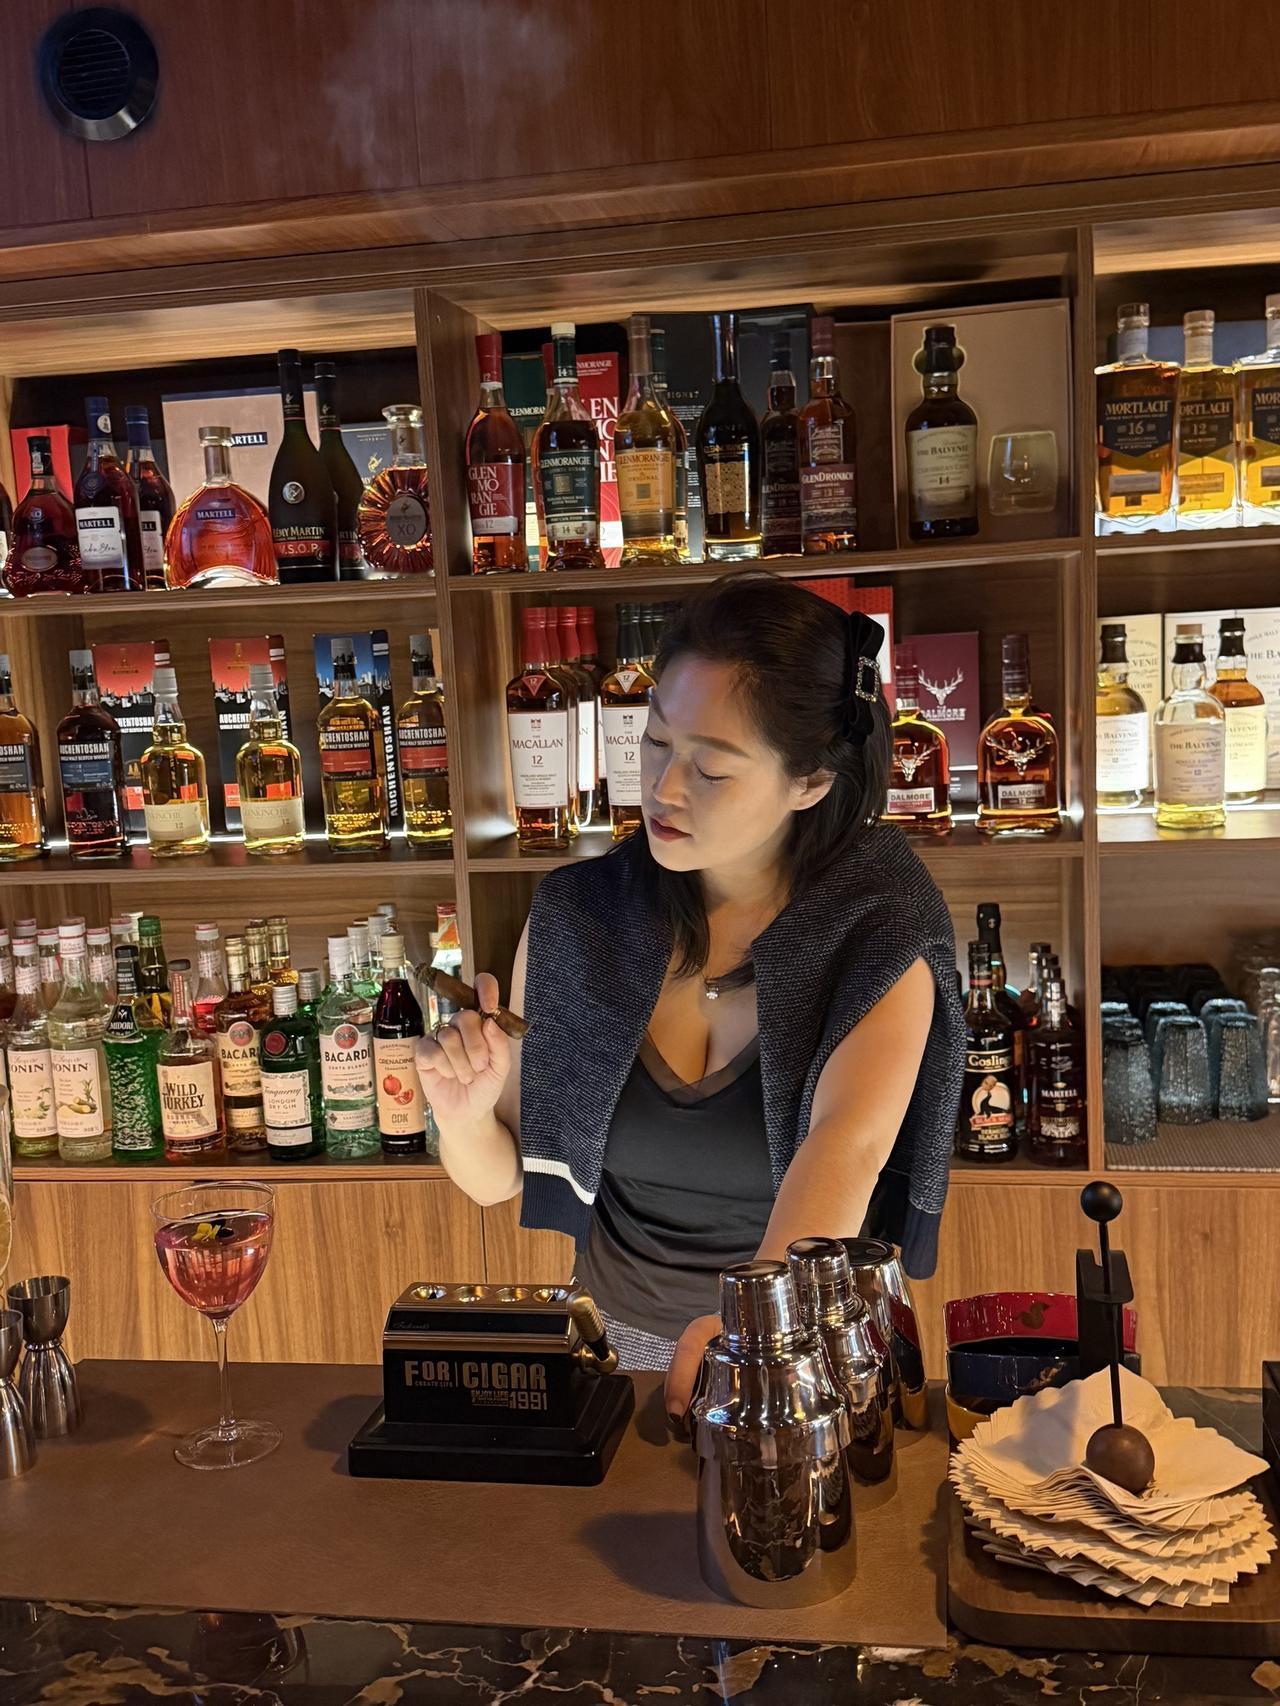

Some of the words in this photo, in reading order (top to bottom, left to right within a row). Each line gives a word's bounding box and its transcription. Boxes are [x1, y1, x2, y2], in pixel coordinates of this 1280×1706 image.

[577, 360, 613, 369] NMORANGIE
[558, 368, 567, 377] 14
[589, 397, 618, 419] EN
[1105, 401, 1168, 415] MORTLACH
[1180, 402, 1230, 416] ORTLACH
[1128, 420, 1144, 435] 16
[1193, 423, 1207, 435] 12
[468, 466, 497, 480] GLEN
[477, 478, 500, 491] MO
[471, 491, 492, 504] RAN
[197, 509, 234, 519] MARTELL
[479, 503, 498, 516] GIE
[79, 519, 113, 528] MARTELL
[485, 520, 494, 529] 12
[290, 526, 325, 537] MARTIN
[397, 524, 416, 535] XO
[562, 525, 571, 534] 14
[1132, 658, 1158, 667] VENIE
[219, 713, 250, 724] AUCHENT
[921, 708, 966, 718] DALMORE
[114, 716, 155, 728] HENTOSHA
[512, 738, 563, 749] MACALLAN
[605, 735, 640, 745] MACAL
[382, 705, 399, 817] AUCHENTOSHAN
[532, 755, 543, 764] 12
[623, 751, 635, 761] 12
[890, 792, 931, 802] DALMORE
[1001, 788, 1043, 798] DALMORE
[110, 1021, 134, 1030] MIDORI
[221, 1047, 259, 1060] BACAR
[10, 1063, 44, 1073] ONIN
[164, 1082, 198, 1097] WILD
[263, 1085, 302, 1097] Tanqueray
[1041, 1089, 1078, 1098] MARTELL
[162, 1093, 206, 1111] TURKEY
[404, 1360, 450, 1387] FOR
[462, 1361, 547, 1390] CIGAR
[509, 1391, 548, 1411] 1991
